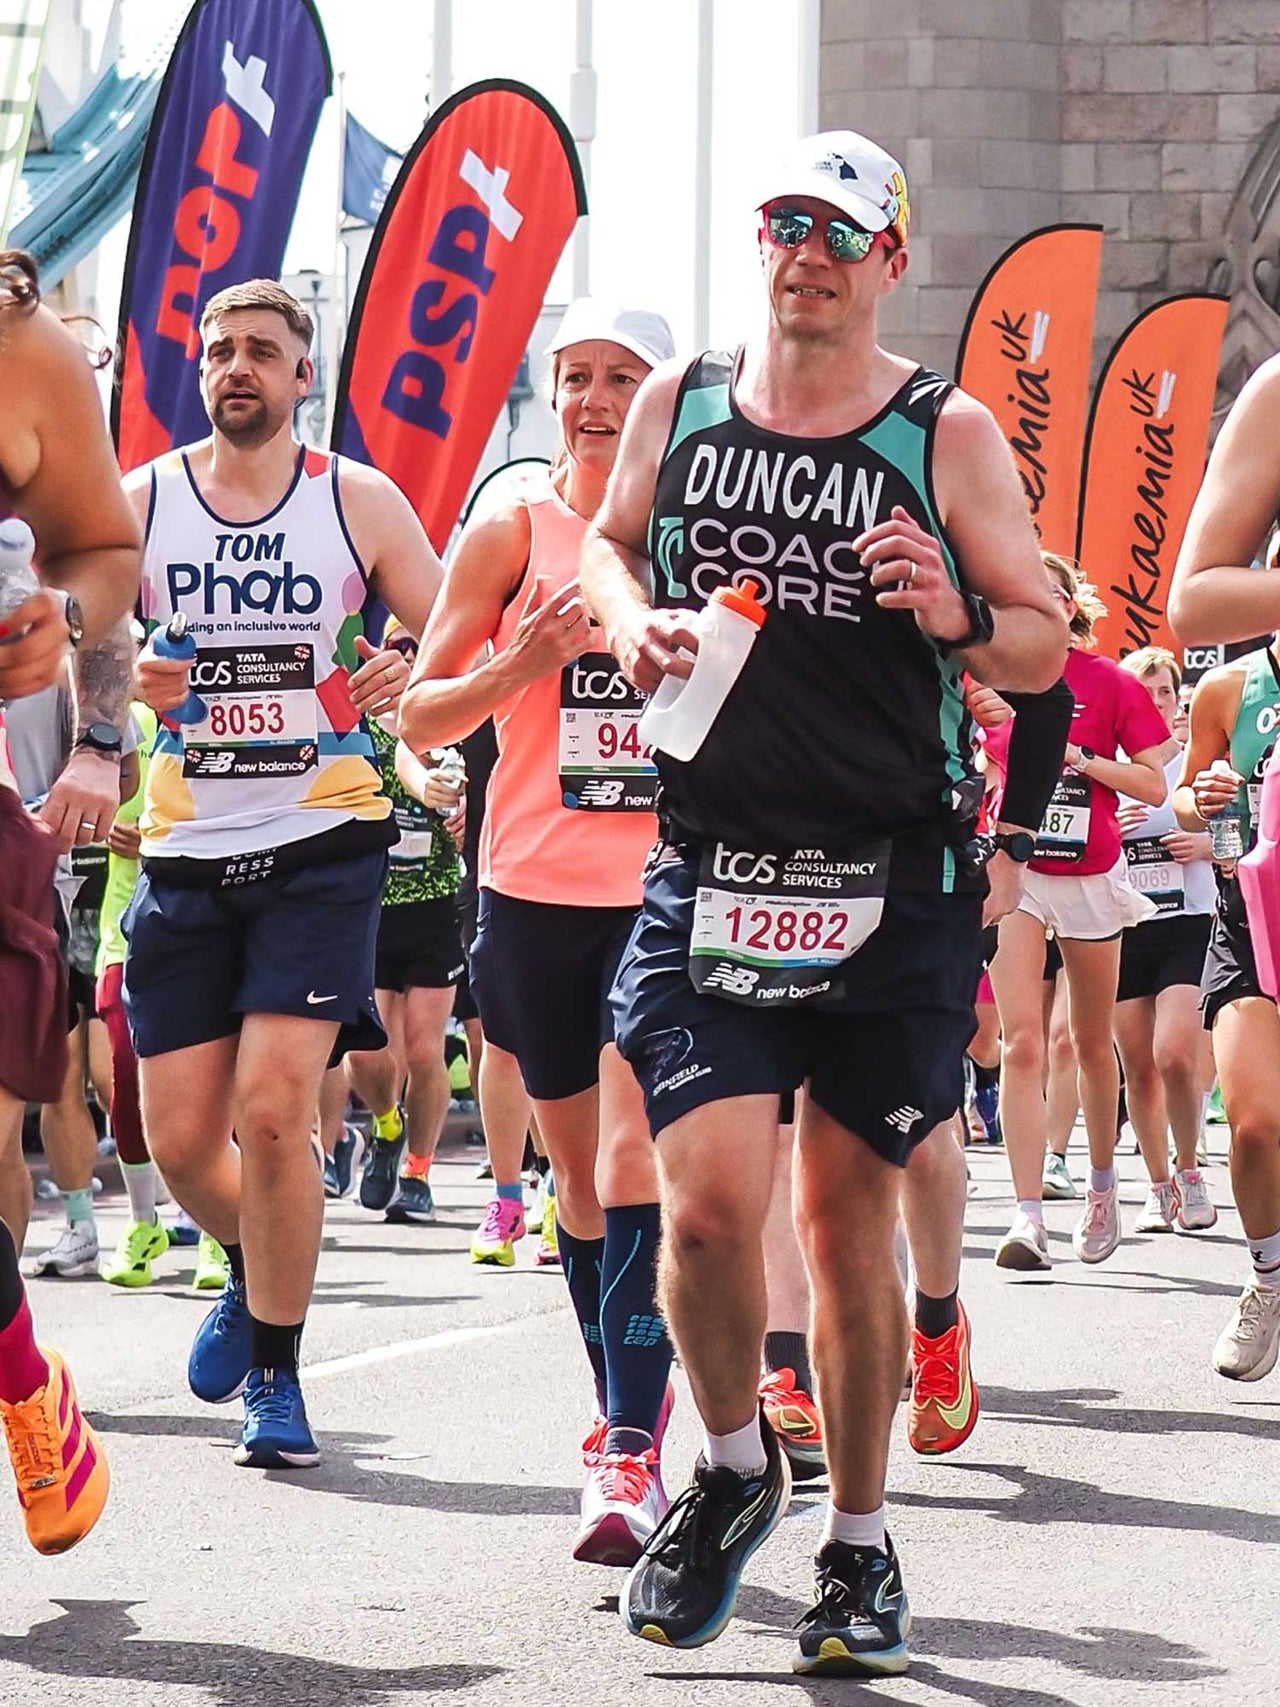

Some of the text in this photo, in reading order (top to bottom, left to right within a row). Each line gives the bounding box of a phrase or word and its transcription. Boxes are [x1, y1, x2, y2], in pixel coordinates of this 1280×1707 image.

[684, 443, 885, 531] DUNCAN
[215, 532, 286, 562] TOM
[690, 517, 870, 582] COAC
[1118, 423, 1174, 660] ukaemia
[167, 561, 323, 616] Phab
[691, 562, 861, 623] CORE
[184, 619, 320, 635] ding an inclusive world
[236, 653, 266, 663] TATA
[236, 661, 306, 674] CONSULTANCY
[236, 673, 281, 685] SERVICES
[210, 702, 286, 736] 8053
[597, 722, 653, 760] 94
[235, 762, 257, 773] new
[259, 759, 306, 772] balance
[624, 795, 654, 806] new
[1045, 848, 1078, 858] balance
[226, 856, 274, 876] RESS
[713, 842, 778, 884] tcs
[784, 860, 877, 875] CONSULTANCY
[782, 873, 843, 889] SERVICES
[724, 906, 850, 952] 12882
[756, 985, 787, 1000] new
[622, 1335, 659, 1348] cep
